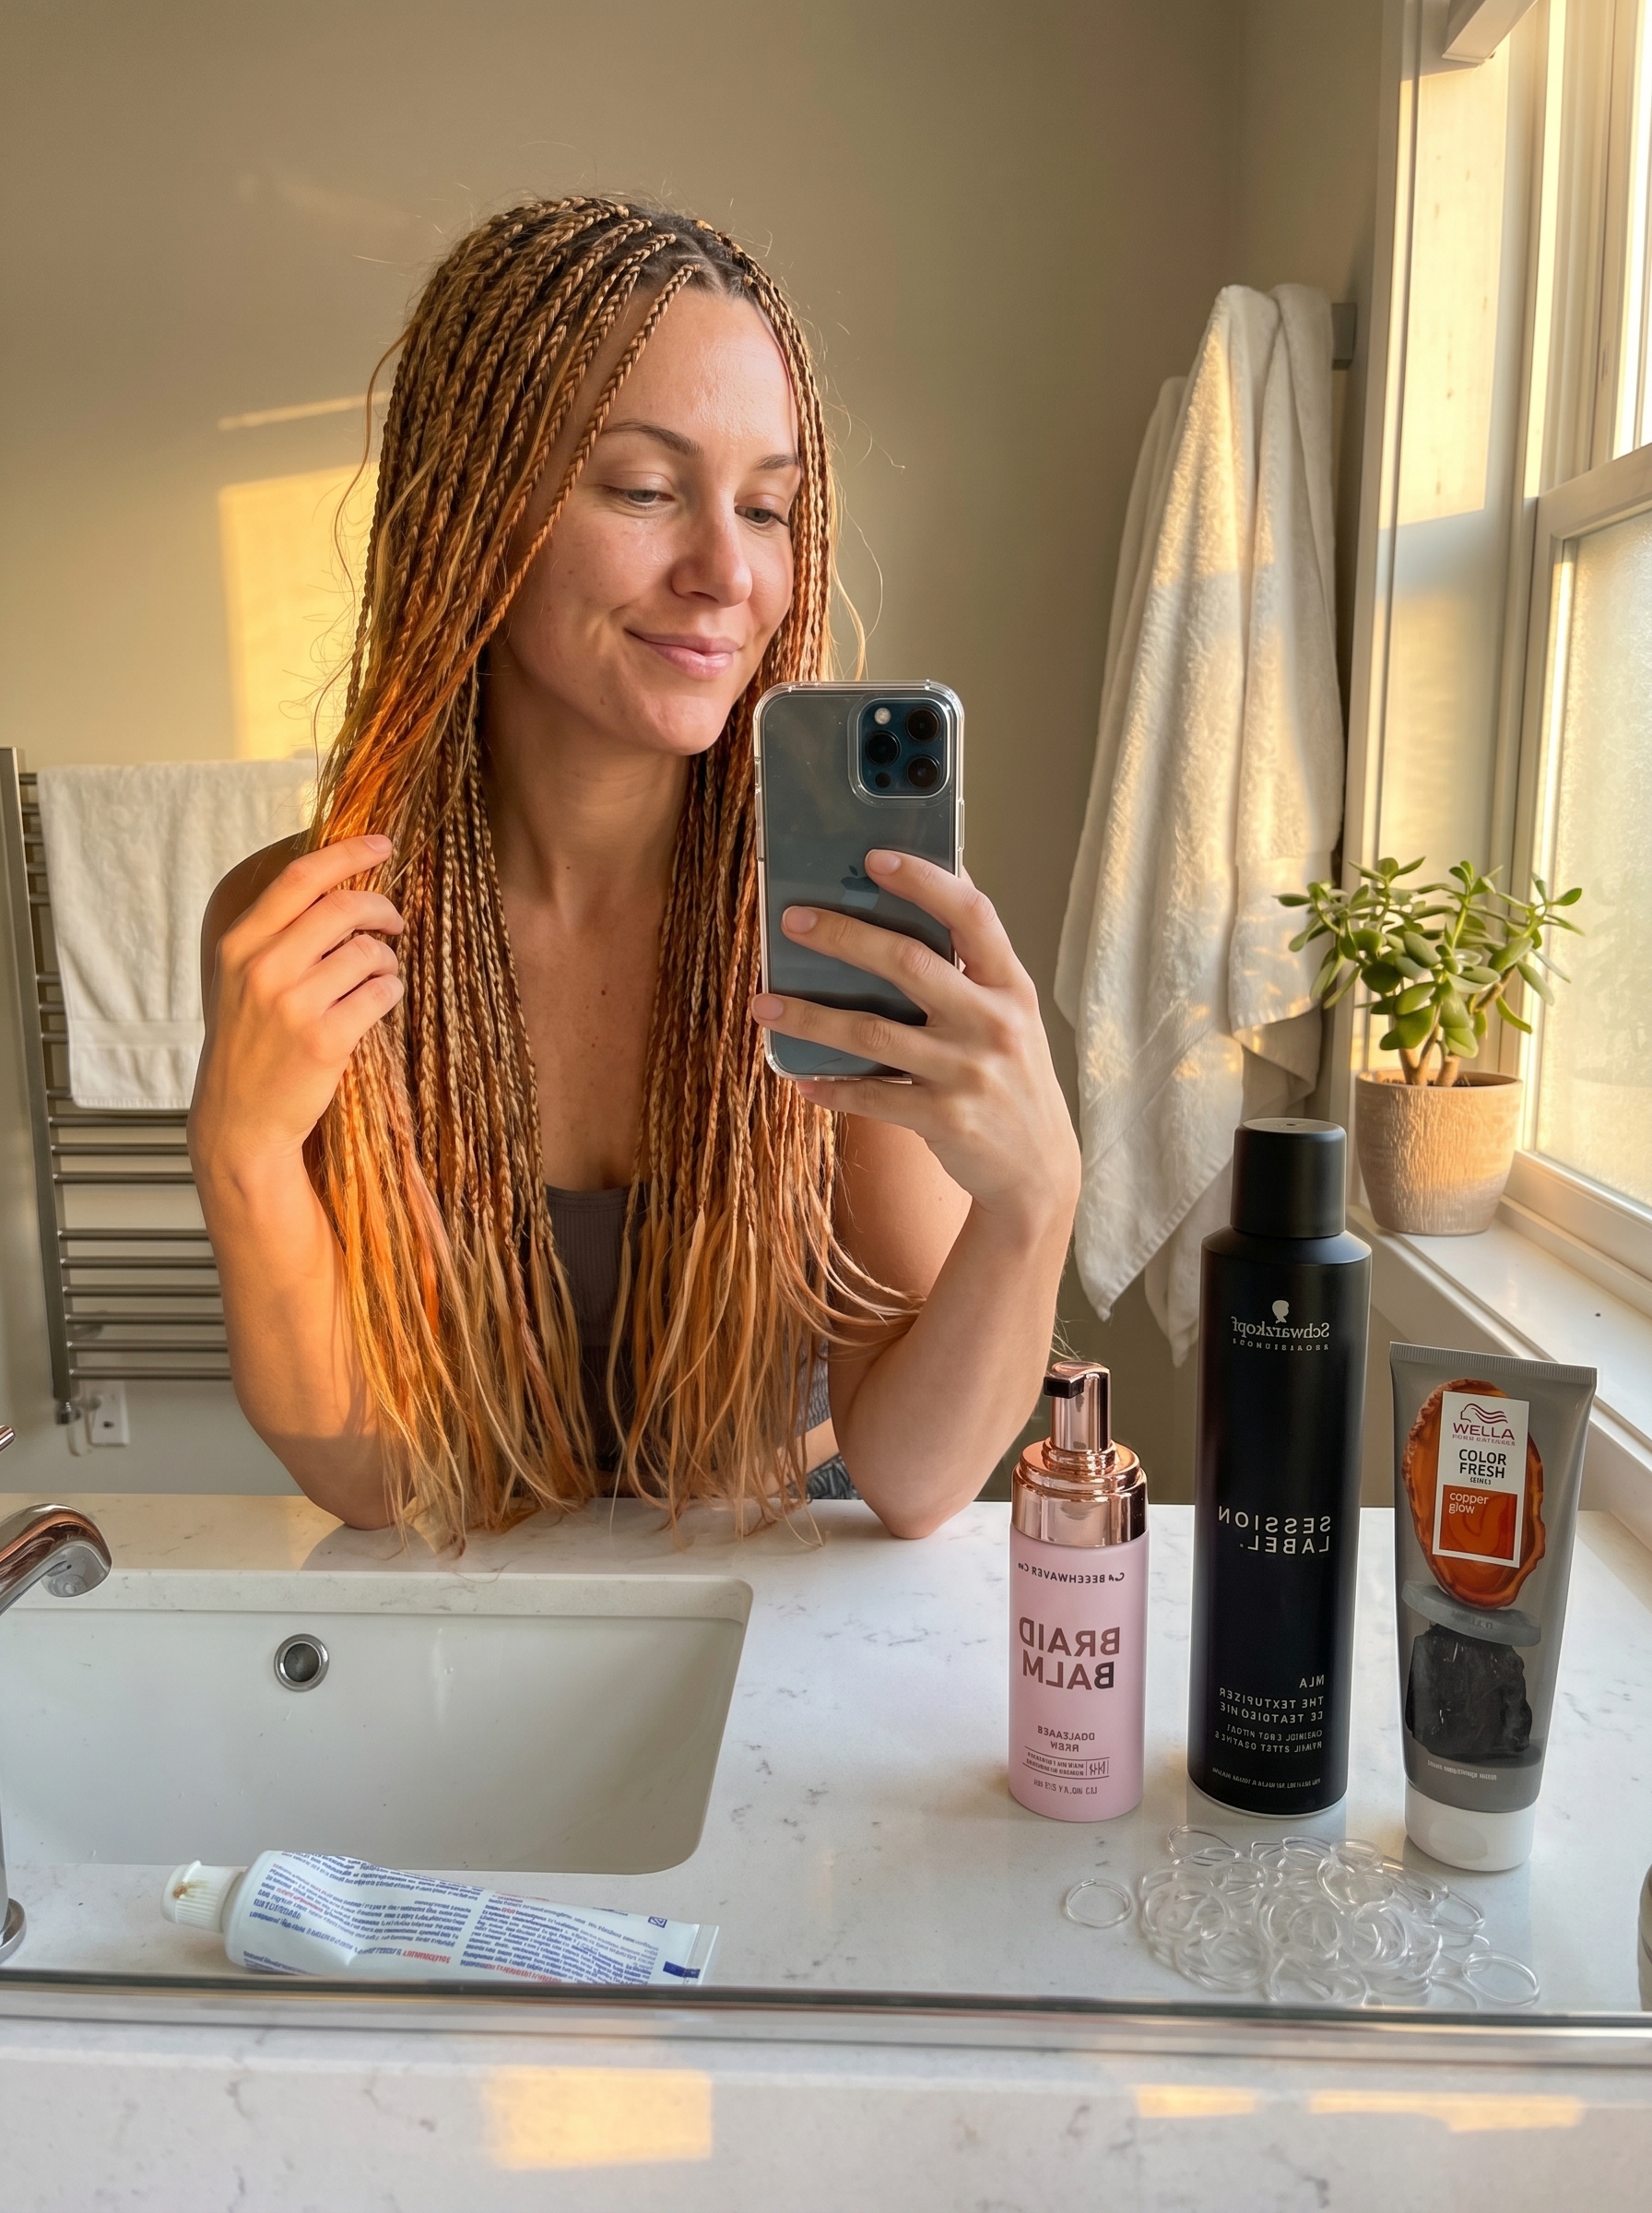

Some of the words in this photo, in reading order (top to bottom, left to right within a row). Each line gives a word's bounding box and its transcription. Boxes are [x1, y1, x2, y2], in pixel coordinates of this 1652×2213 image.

[1453, 1423, 1515, 1440] WELLA
[1458, 1449, 1507, 1466] COLOR
[1459, 1462, 1505, 1479] FRESH
[1449, 1492, 1489, 1505] copper
[1448, 1502, 1475, 1514] glow
